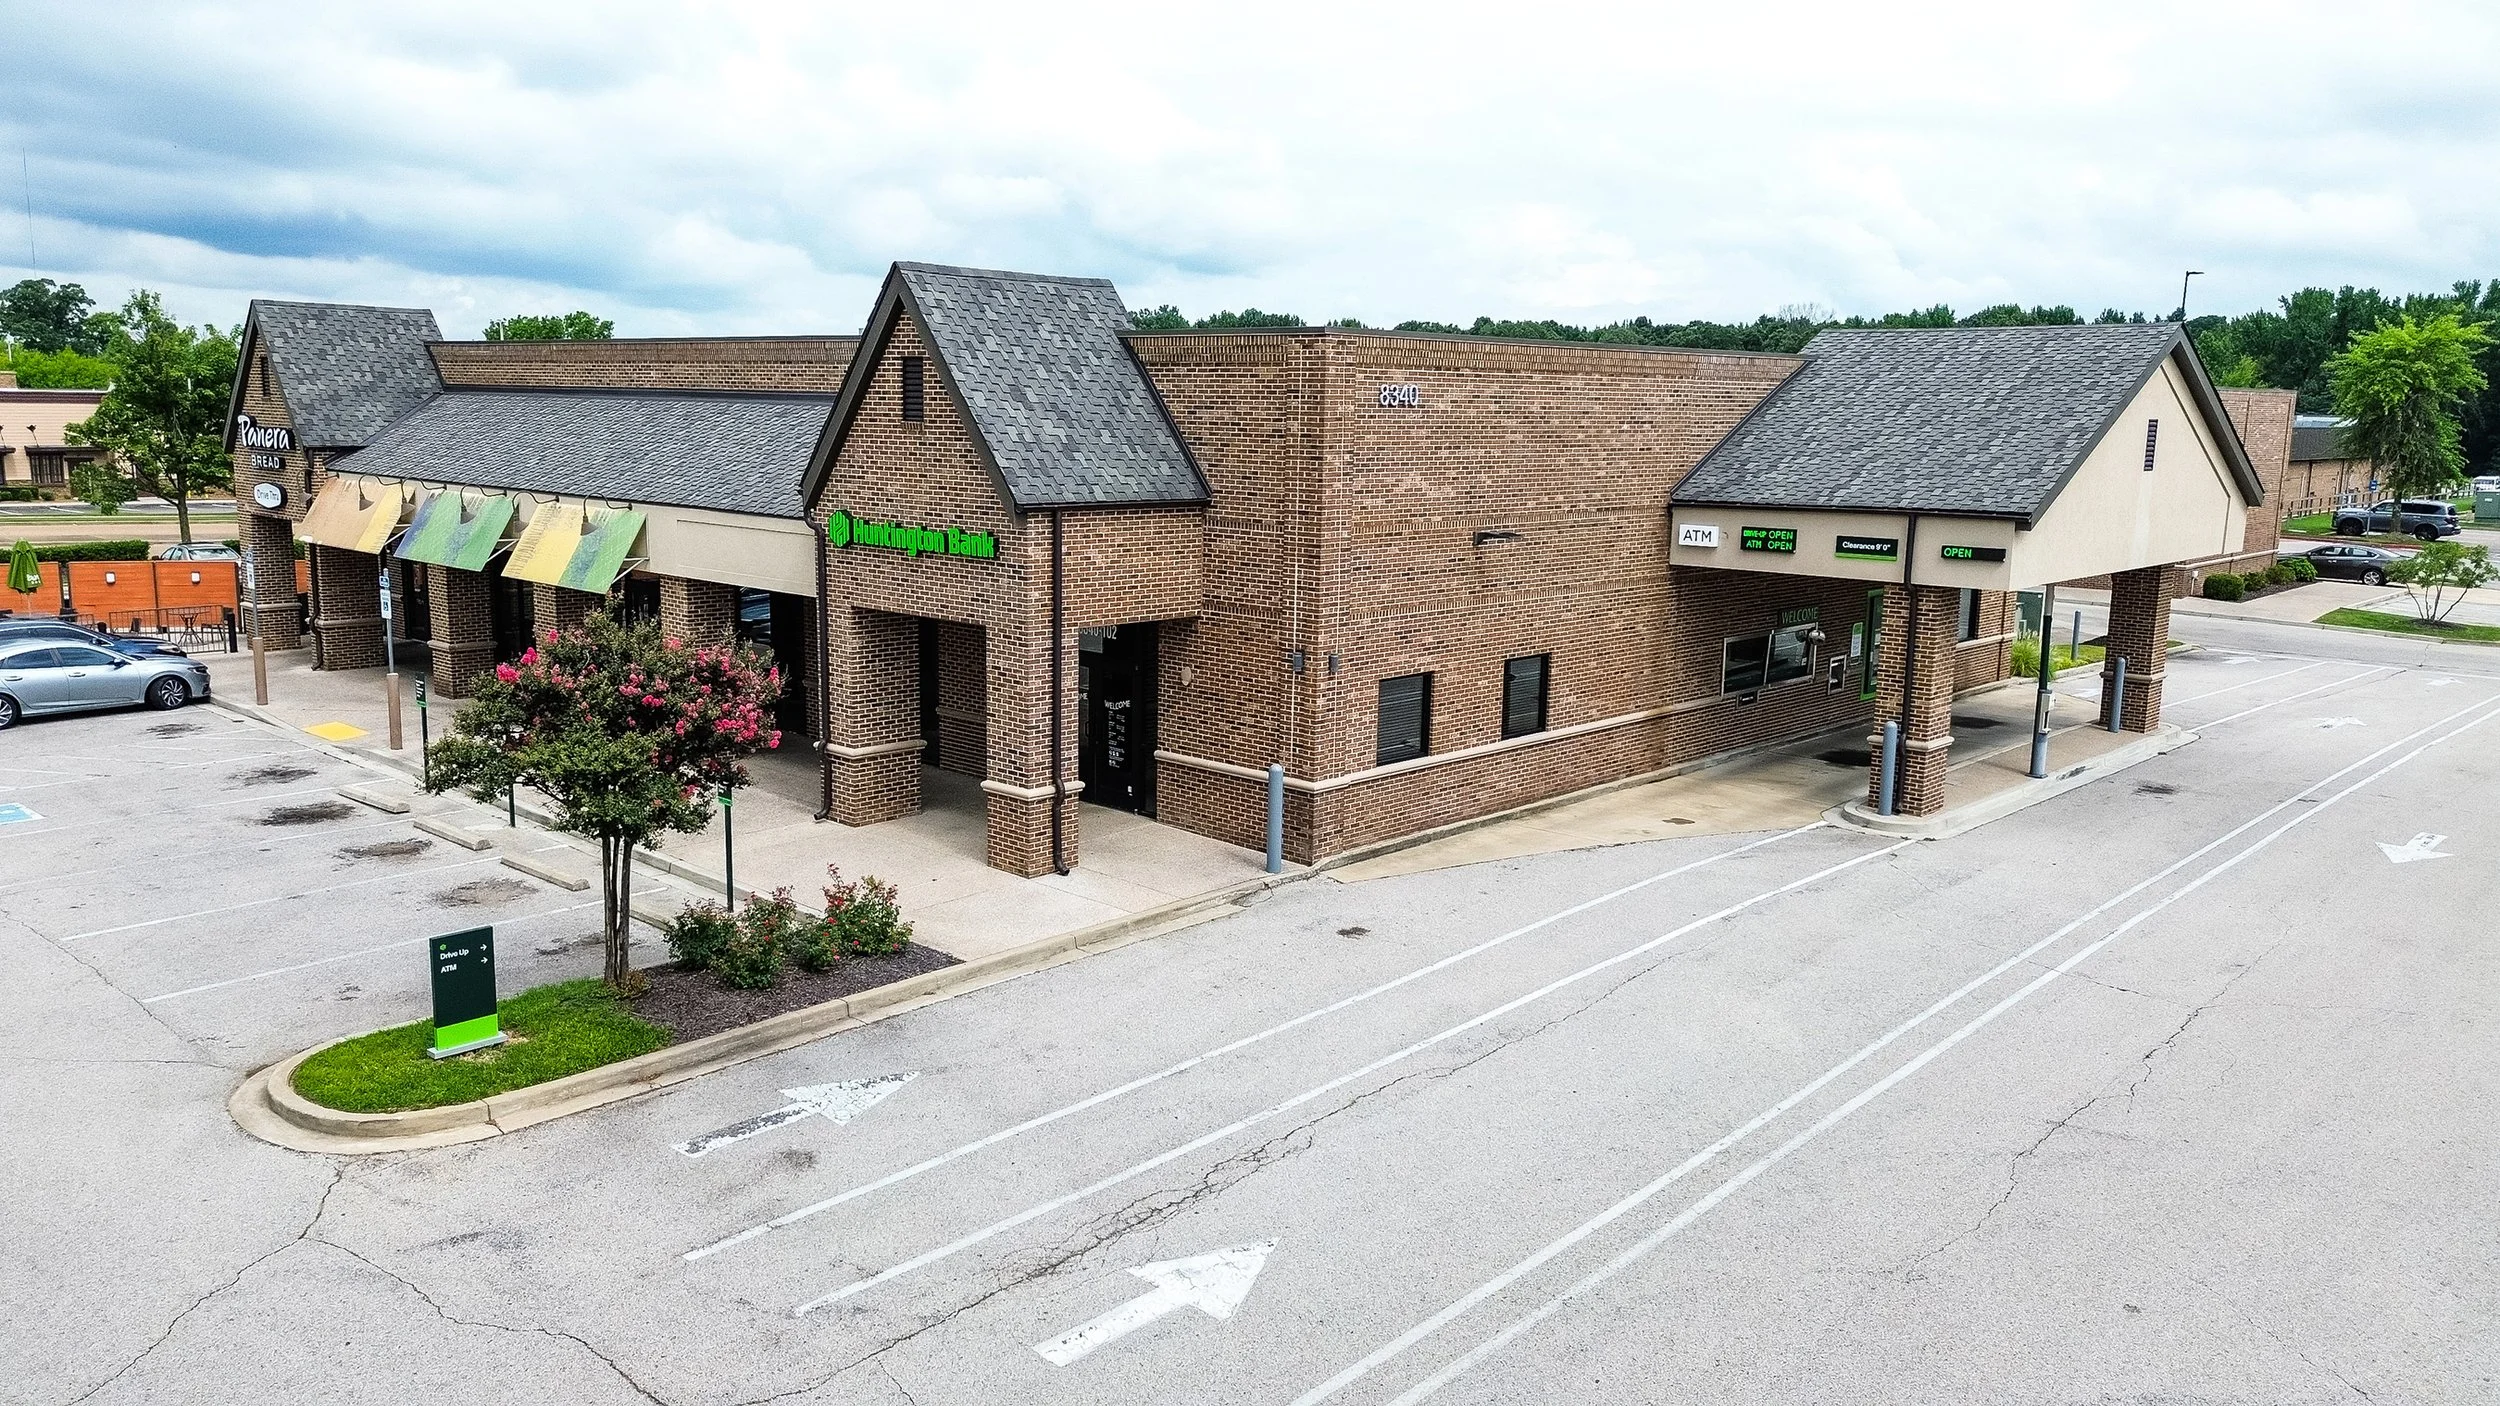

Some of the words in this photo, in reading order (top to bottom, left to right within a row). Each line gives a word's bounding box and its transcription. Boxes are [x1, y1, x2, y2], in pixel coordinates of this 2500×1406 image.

[1380, 384, 1418, 406] 8340
[237, 414, 290, 450] Panera
[251, 454, 280, 469] BREAD
[853, 518, 945, 557] Huntington
[948, 527, 995, 558] Bank
[1683, 529, 1713, 542] ATM
[1768, 530, 1793, 540] OPEN
[1746, 540, 1762, 549] ATM
[1767, 540, 1792, 550] OPEN
[1842, 541, 1875, 550] Clearance
[1944, 547, 1972, 559] OPEN
[1781, 607, 1819, 624] WELCOME
[1104, 699, 1131, 710] WELCOME
[440, 951, 458, 960] Drive
[459, 949, 469, 957] Up
[441, 964, 457, 974] ATM
